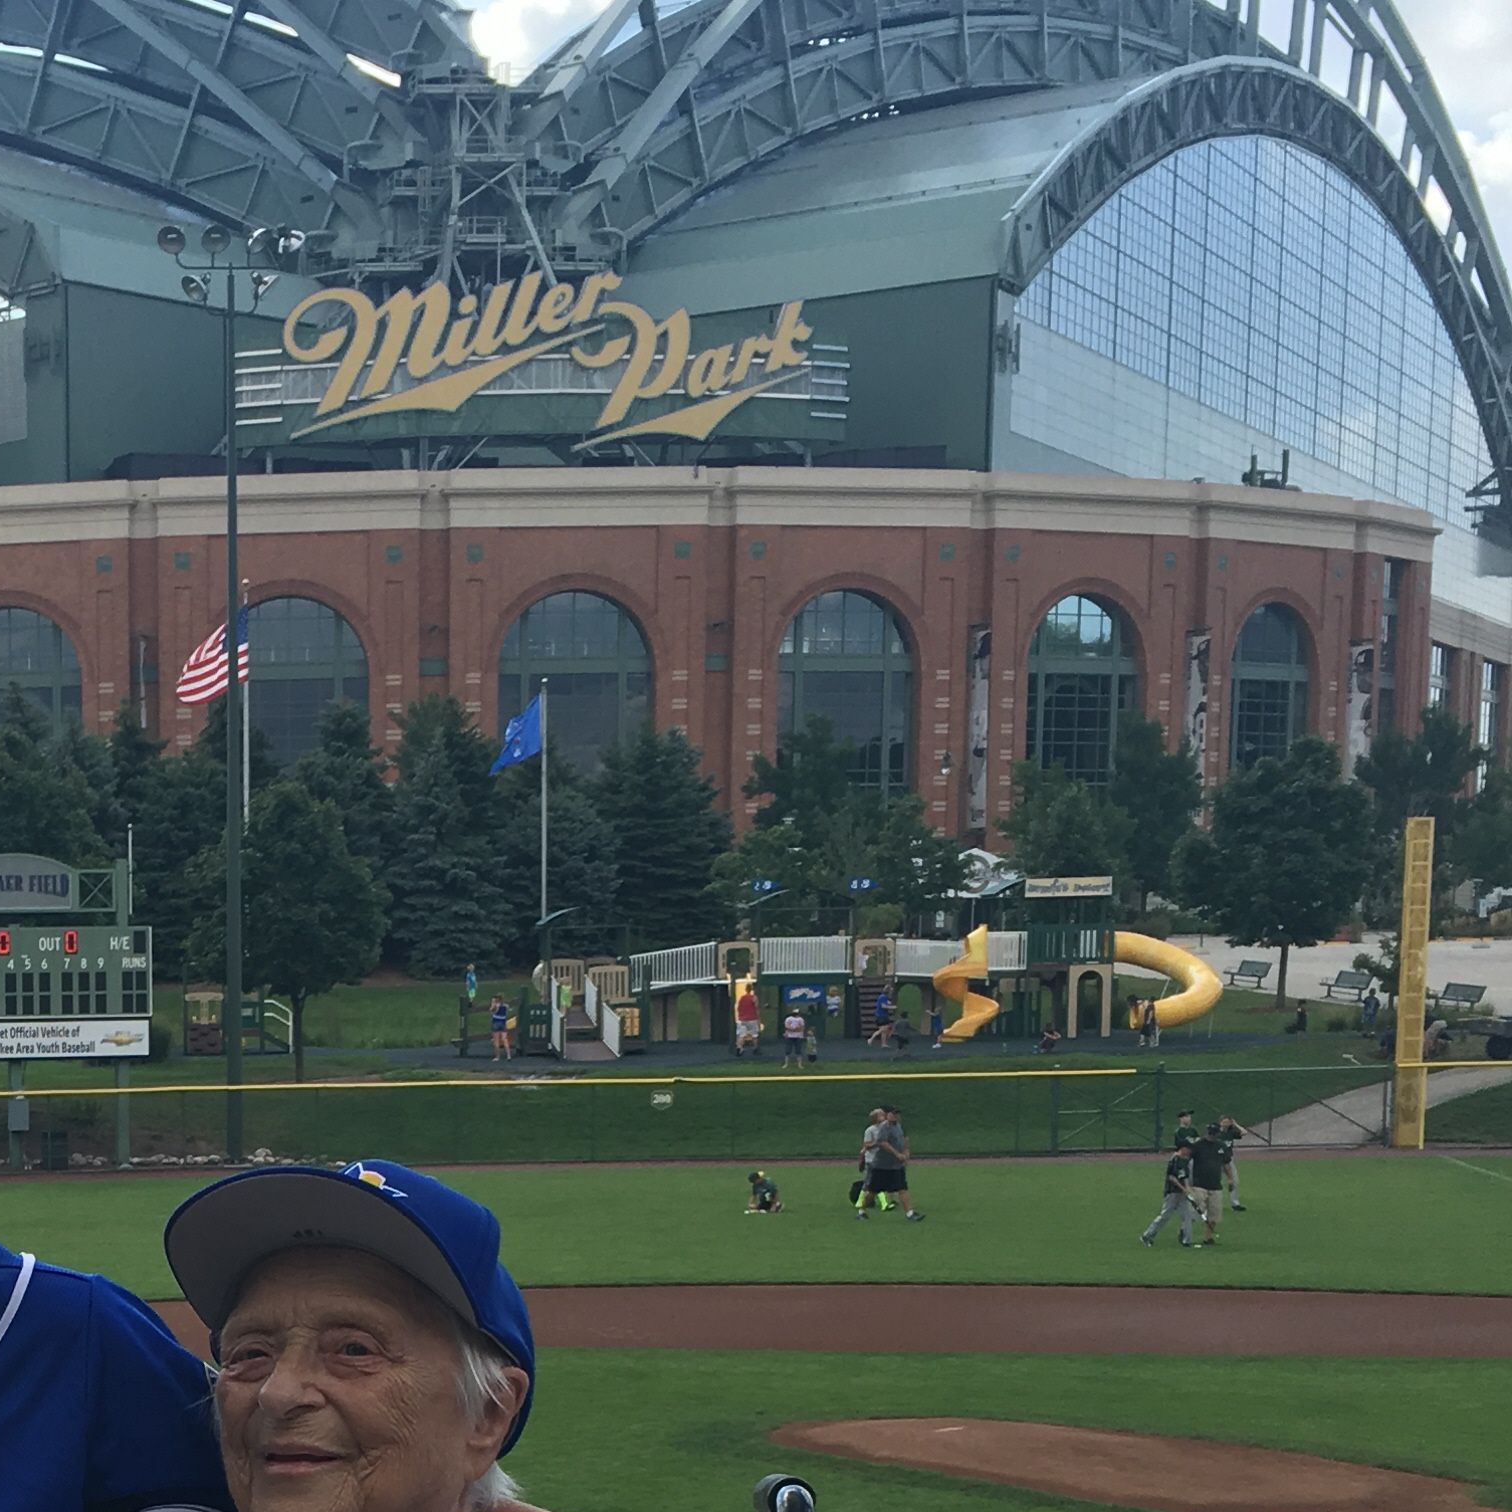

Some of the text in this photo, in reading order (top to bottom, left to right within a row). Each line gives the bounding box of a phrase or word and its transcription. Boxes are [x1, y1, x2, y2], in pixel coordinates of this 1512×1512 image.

[284, 270, 814, 430] Miller Park
[28, 873, 69, 898] FIELD
[38, 937, 61, 951] OUT
[63, 930, 79, 955] 0
[109, 936, 131, 951] H/E
[7, 958, 15, 971] 4
[24, 957, 31, 970] 5
[41, 957, 48, 969] 6
[64, 957, 71, 969] 7
[80, 957, 88, 969] 8
[97, 956, 105, 969] 9
[121, 956, 147, 969] RUNS
[9, 1025, 39, 1039] Official
[40, 1026, 70, 1038] Vehicle
[71, 1025, 80, 1038] of
[15, 1043, 35, 1054] Area
[35, 1042, 60, 1054] Youth
[61, 1041, 96, 1054] Baseball
